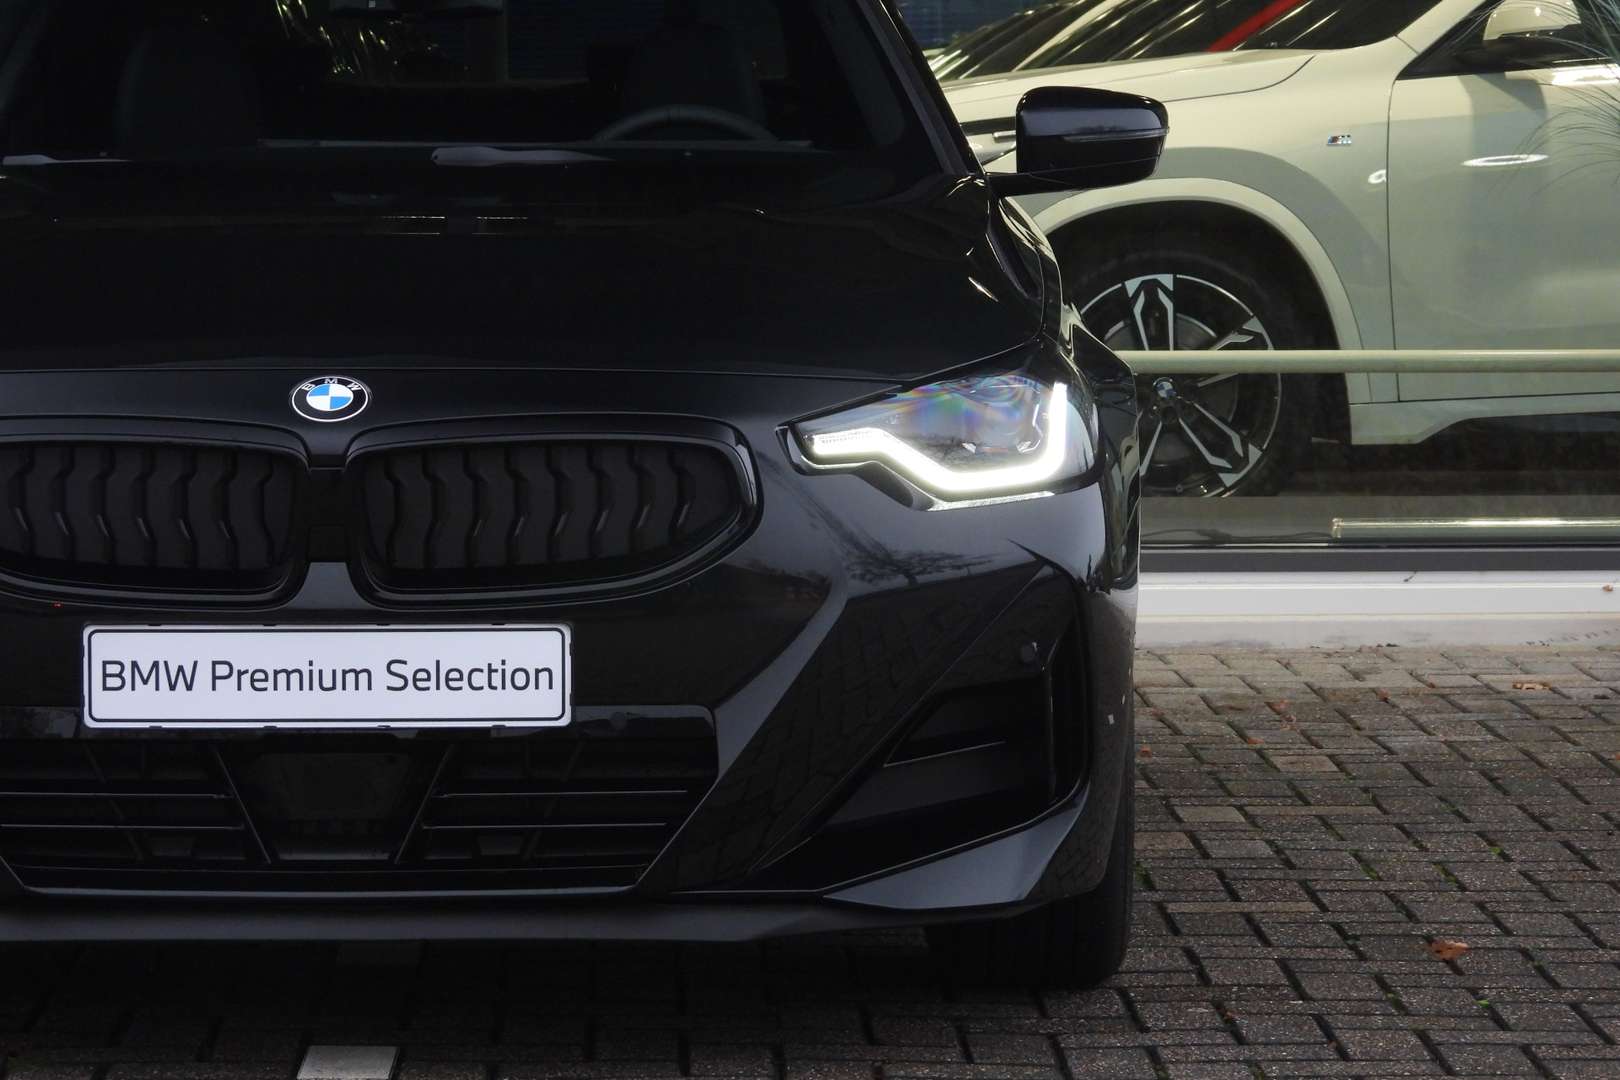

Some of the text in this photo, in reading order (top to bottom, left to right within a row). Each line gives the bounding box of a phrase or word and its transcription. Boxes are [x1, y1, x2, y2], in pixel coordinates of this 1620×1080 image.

[301, 378, 362, 391] BMW
[101, 659, 554, 691] BMW Premium Selection
